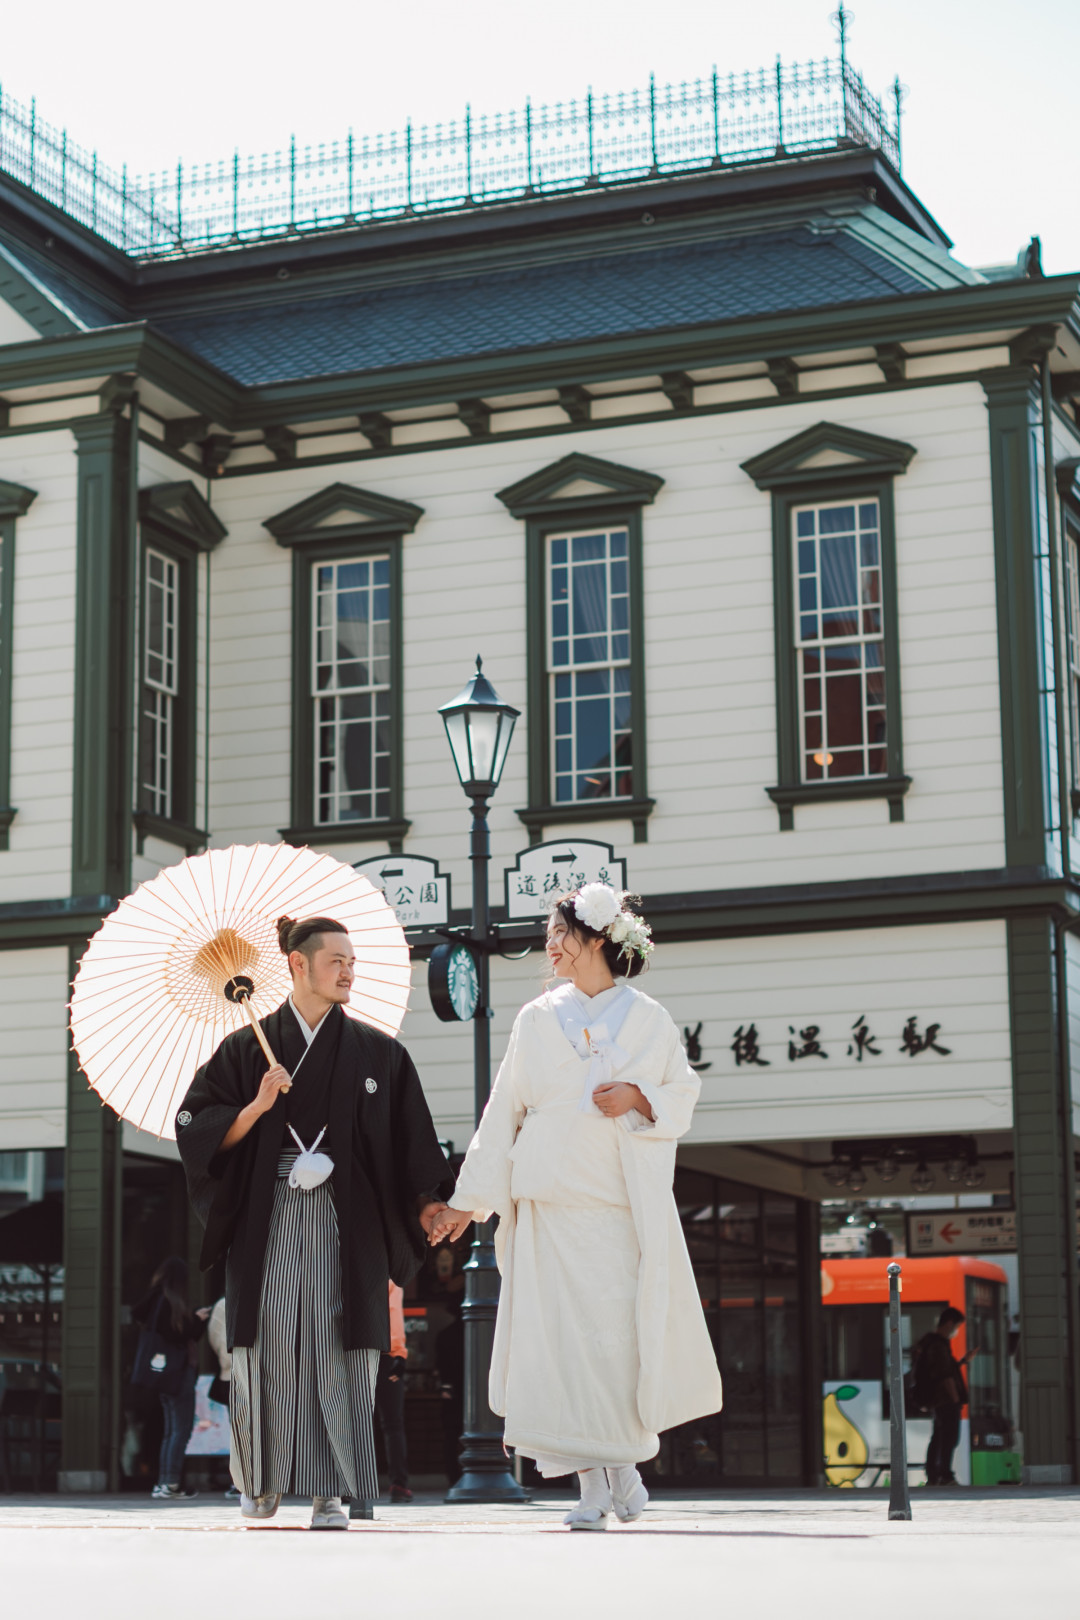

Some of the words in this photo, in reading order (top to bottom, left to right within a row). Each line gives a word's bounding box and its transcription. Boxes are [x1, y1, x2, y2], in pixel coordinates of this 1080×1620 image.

[383, 881, 438, 906] 公園
[516, 867, 614, 897] 道後温泉
